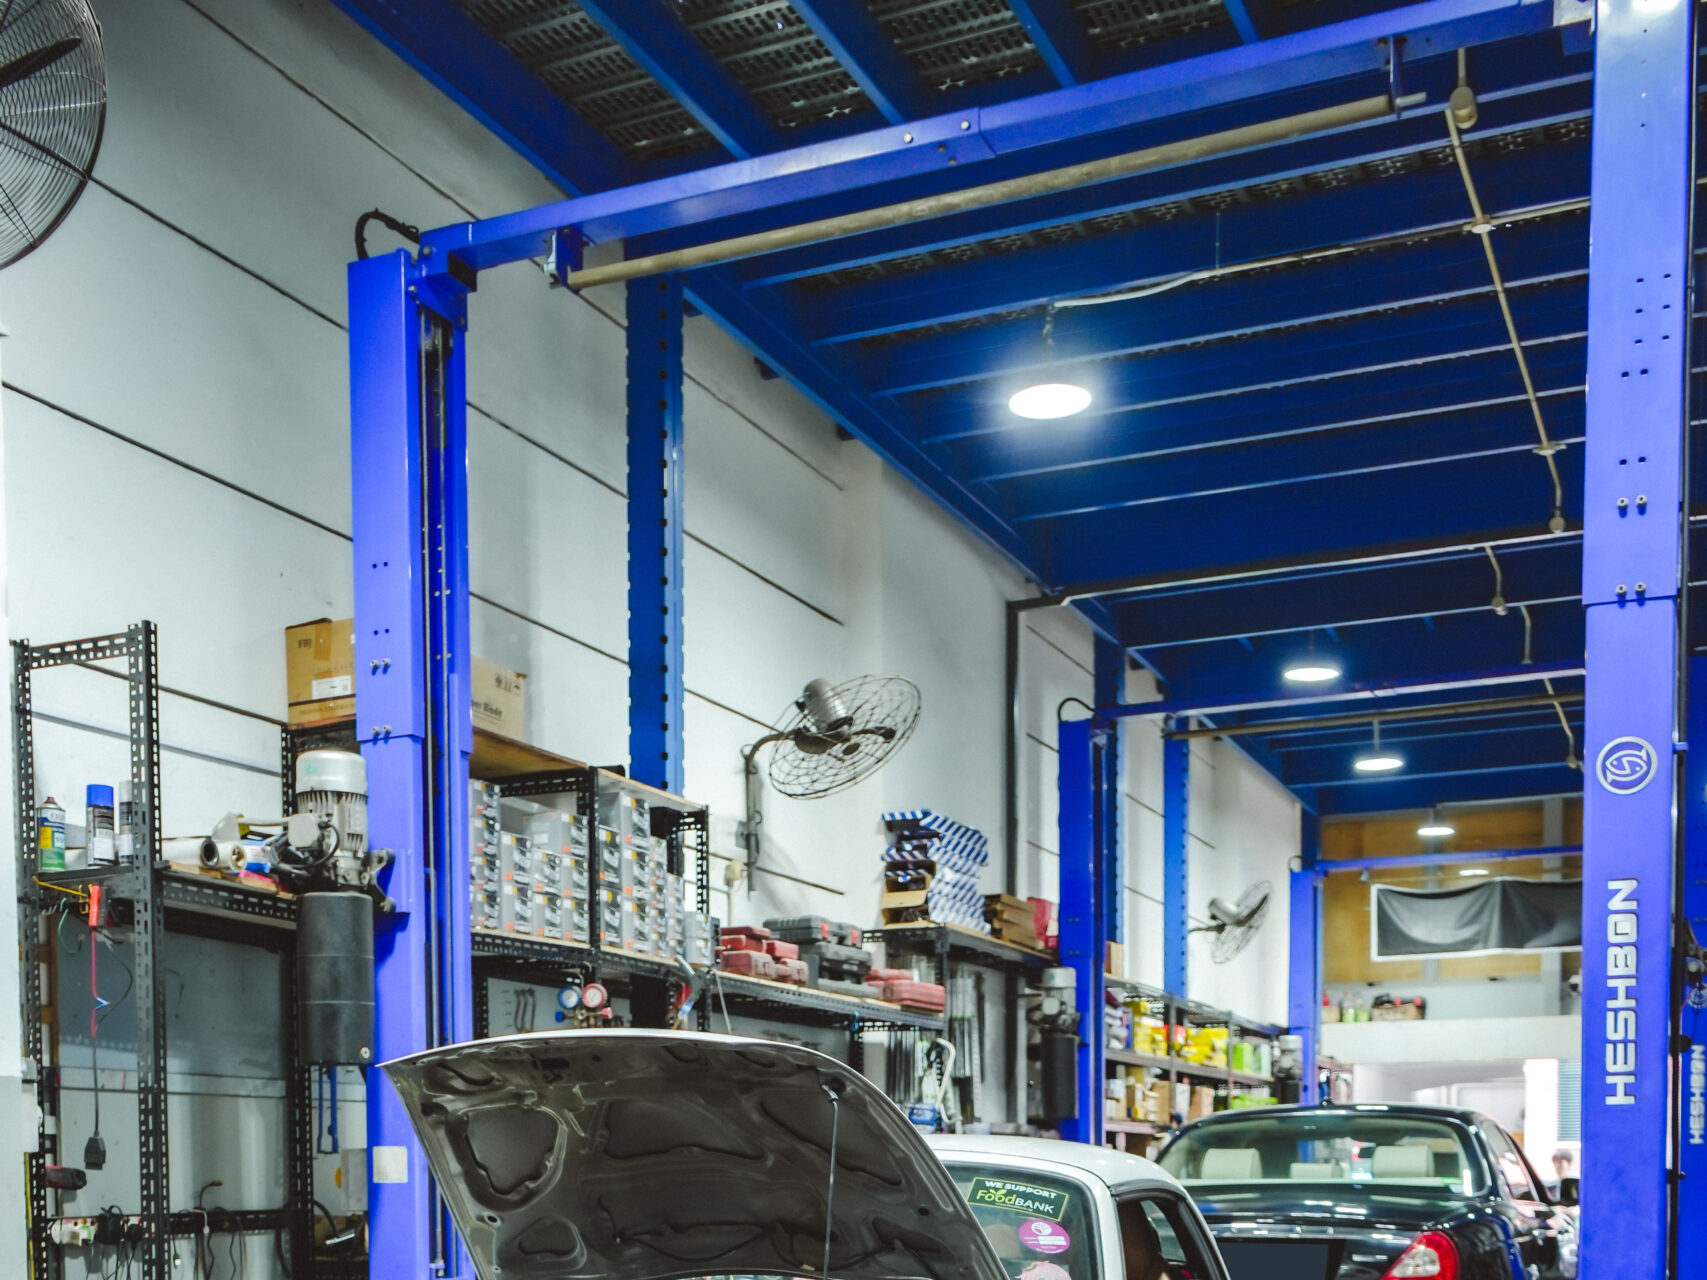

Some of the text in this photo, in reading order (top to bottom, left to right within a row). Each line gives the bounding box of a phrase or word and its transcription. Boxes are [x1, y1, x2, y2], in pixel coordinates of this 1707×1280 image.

[1606, 879, 1638, 1105] HESHBON
[1689, 1044, 1706, 1144] HESHBON
[985, 1180, 1057, 1199] WE SUPPORT
